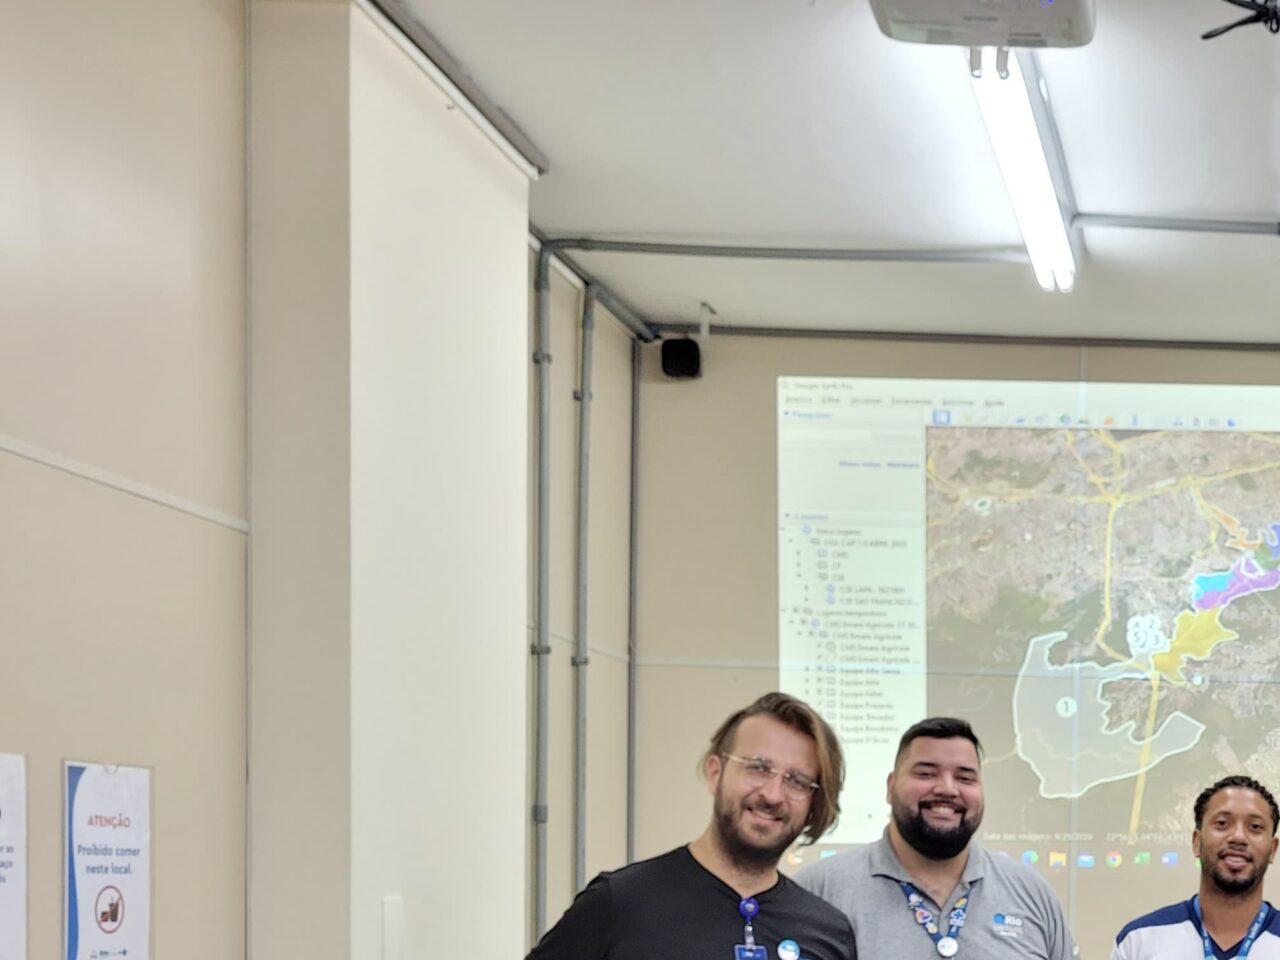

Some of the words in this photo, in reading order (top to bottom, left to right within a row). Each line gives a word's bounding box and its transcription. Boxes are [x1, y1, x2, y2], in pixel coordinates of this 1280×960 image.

[87, 812, 132, 830] ATENÇÃO
[77, 843, 114, 857] Proibido
[115, 847, 141, 857] comer
[86, 864, 109, 875] neste
